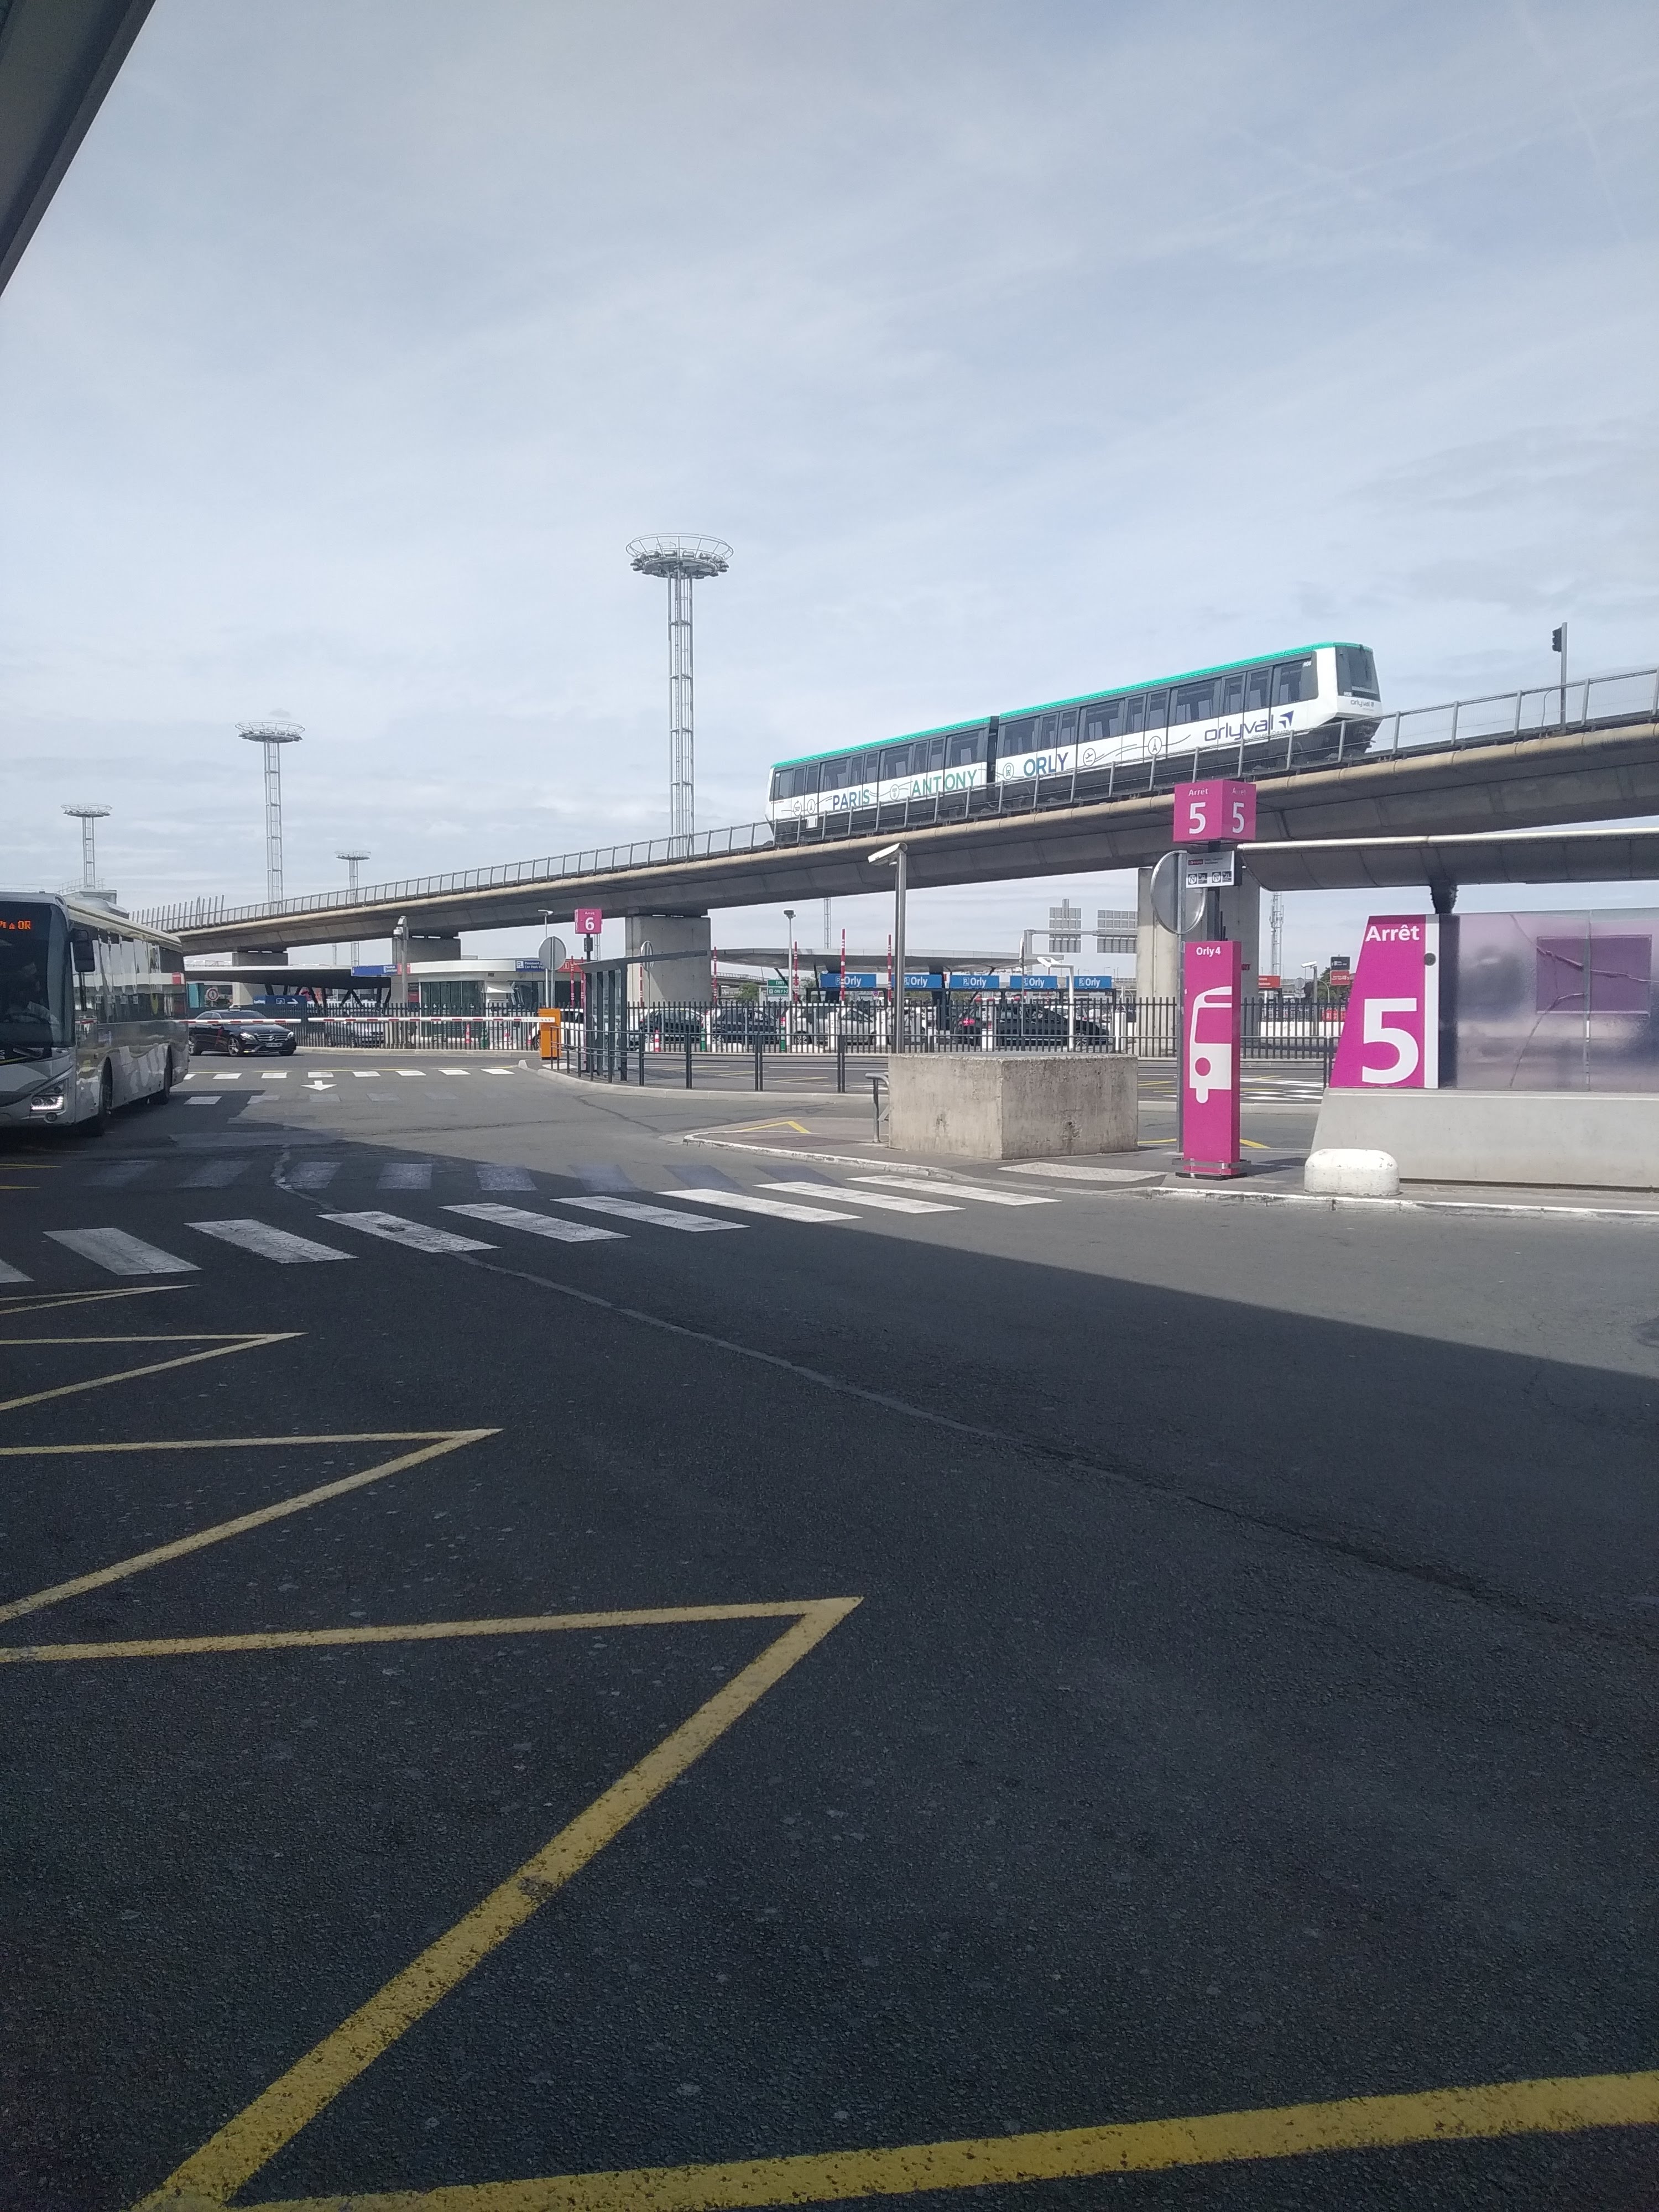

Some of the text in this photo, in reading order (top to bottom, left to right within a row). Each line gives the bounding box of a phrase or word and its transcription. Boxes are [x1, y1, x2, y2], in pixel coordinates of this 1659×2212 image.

[1204, 714, 1274, 741] orlyval
[1024, 752, 1069, 777] ORLY
[833, 770, 978, 810] PARIS ANTONY
[1188, 788, 1208, 796] Arrêt
[1189, 802, 1206, 834] 5
[1232, 802, 1244, 833] 5
[585, 917, 594, 930] 6
[1365, 925, 1420, 942] Arrêt
[844, 975, 862, 987] Orly
[910, 977, 928, 987] Orly
[970, 977, 987, 988] Orly
[1029, 978, 1045, 988] Orly
[1086, 978, 1100, 988] Orly
[1361, 998, 1419, 1084] 5
